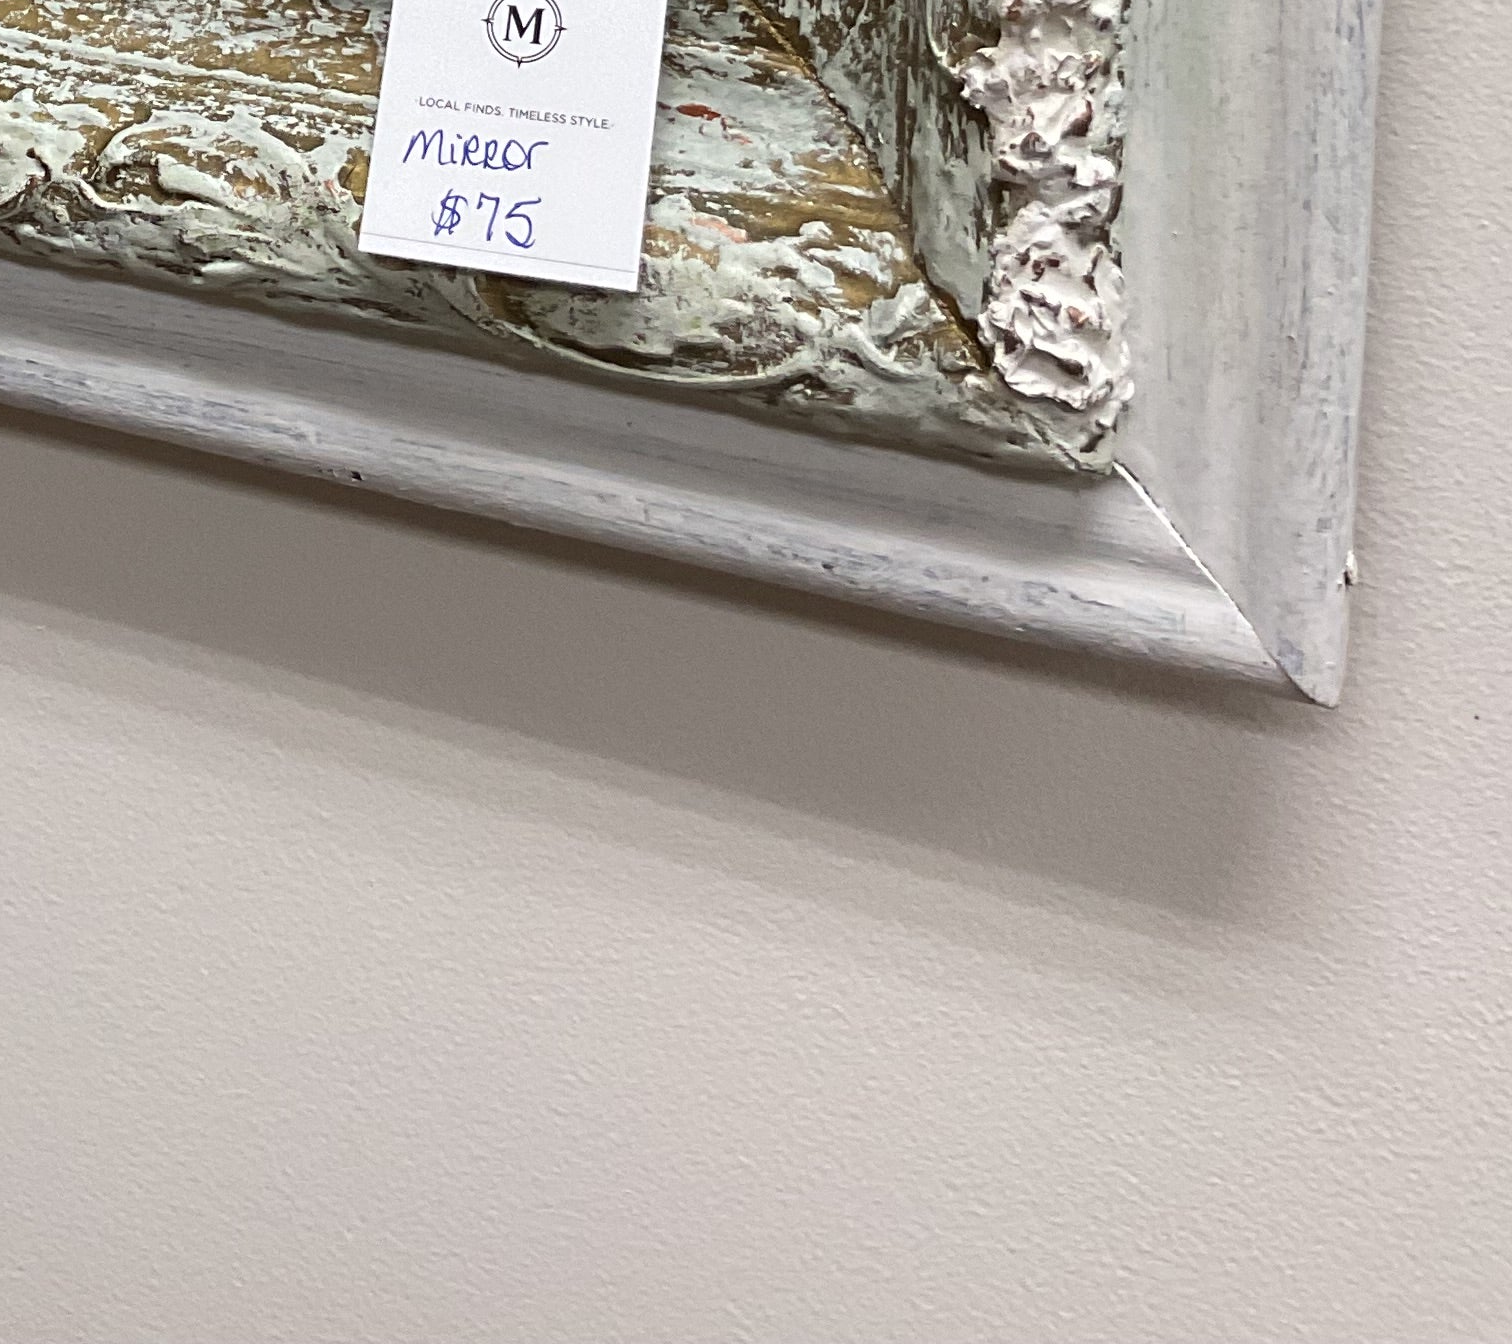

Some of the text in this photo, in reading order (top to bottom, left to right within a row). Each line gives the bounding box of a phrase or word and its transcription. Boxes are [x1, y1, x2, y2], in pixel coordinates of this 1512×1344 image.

[503, 4, 545, 46] M
[419, 96, 460, 112] LOCAL
[464, 102, 505, 117] FINDS.
[509, 107, 567, 124] TIMELESS
[431, 188, 542, 249] $75
